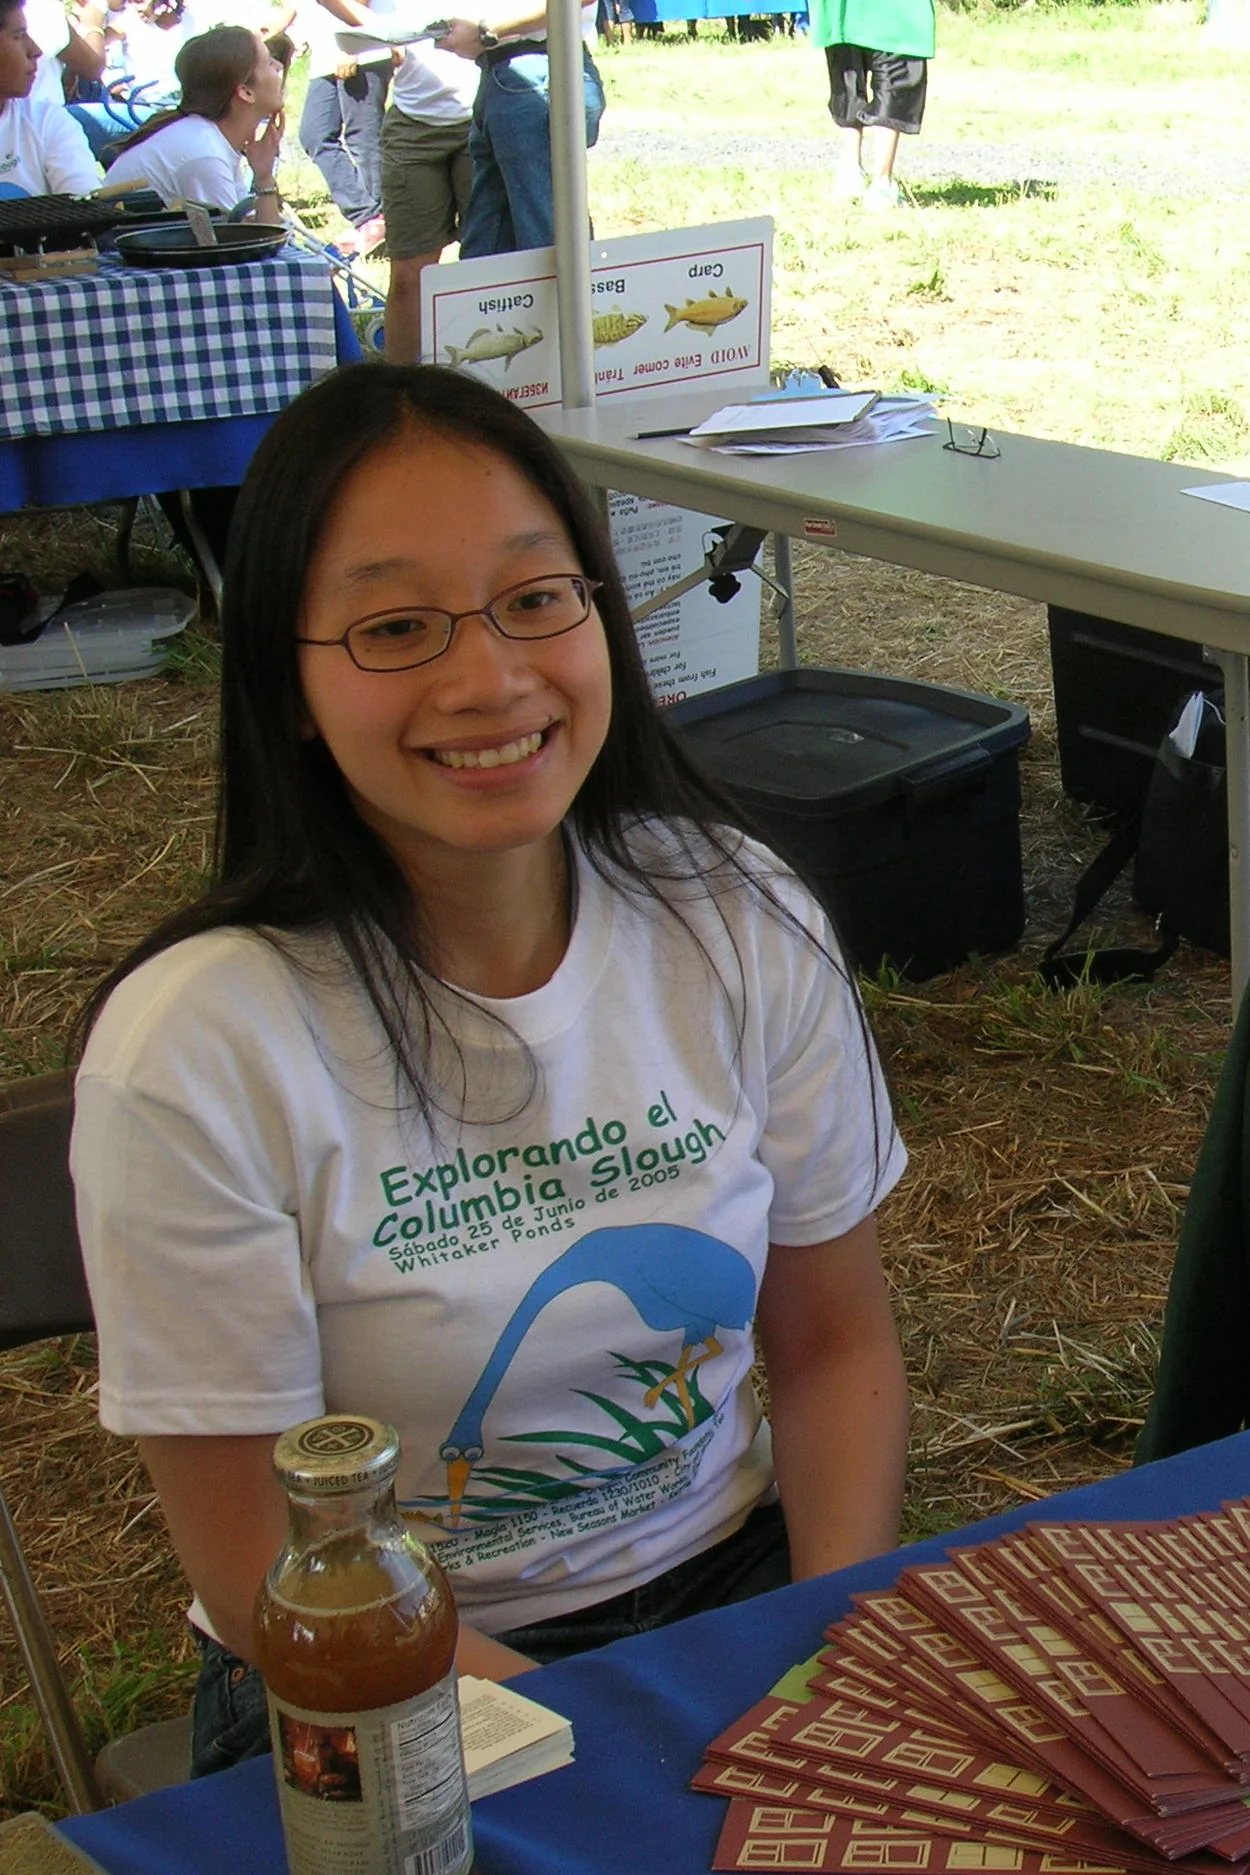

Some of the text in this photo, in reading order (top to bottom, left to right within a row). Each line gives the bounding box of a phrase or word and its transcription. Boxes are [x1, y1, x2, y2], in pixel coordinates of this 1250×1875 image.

[688, 263, 724, 278] Carp
[591, 279, 625, 294] Bass
[478, 293, 534, 315] Catfish
[633, 353, 703, 376] Evite comer
[710, 344, 751, 365] AVOID
[674, 662, 687, 671] for
[678, 673, 699, 682] from
[700, 668, 717, 680] Fish
[379, 1090, 678, 1207] Explorando el
[372, 1118, 727, 1248] Columbia Slough
[388, 1165, 681, 1262] Sábado 25 de Junio de 2005
[393, 1217, 576, 1275] Whitaker Ponds
[313, 1471, 370, 1487] JUICED TEA
[474, 1522, 507, 1540] Magia
[510, 1511, 538, 1528] 1150
[551, 1495, 599, 1518] Recuerdo
[602, 1476, 660, 1501] 1230/1010
[437, 1533, 513, 1562] Environmental
[569, 1508, 605, 1523] Bureau
[608, 1501, 619, 1512] of
[624, 1489, 657, 1507] Water
[465, 1502, 656, 1566] & Recreation New Seasons Market
